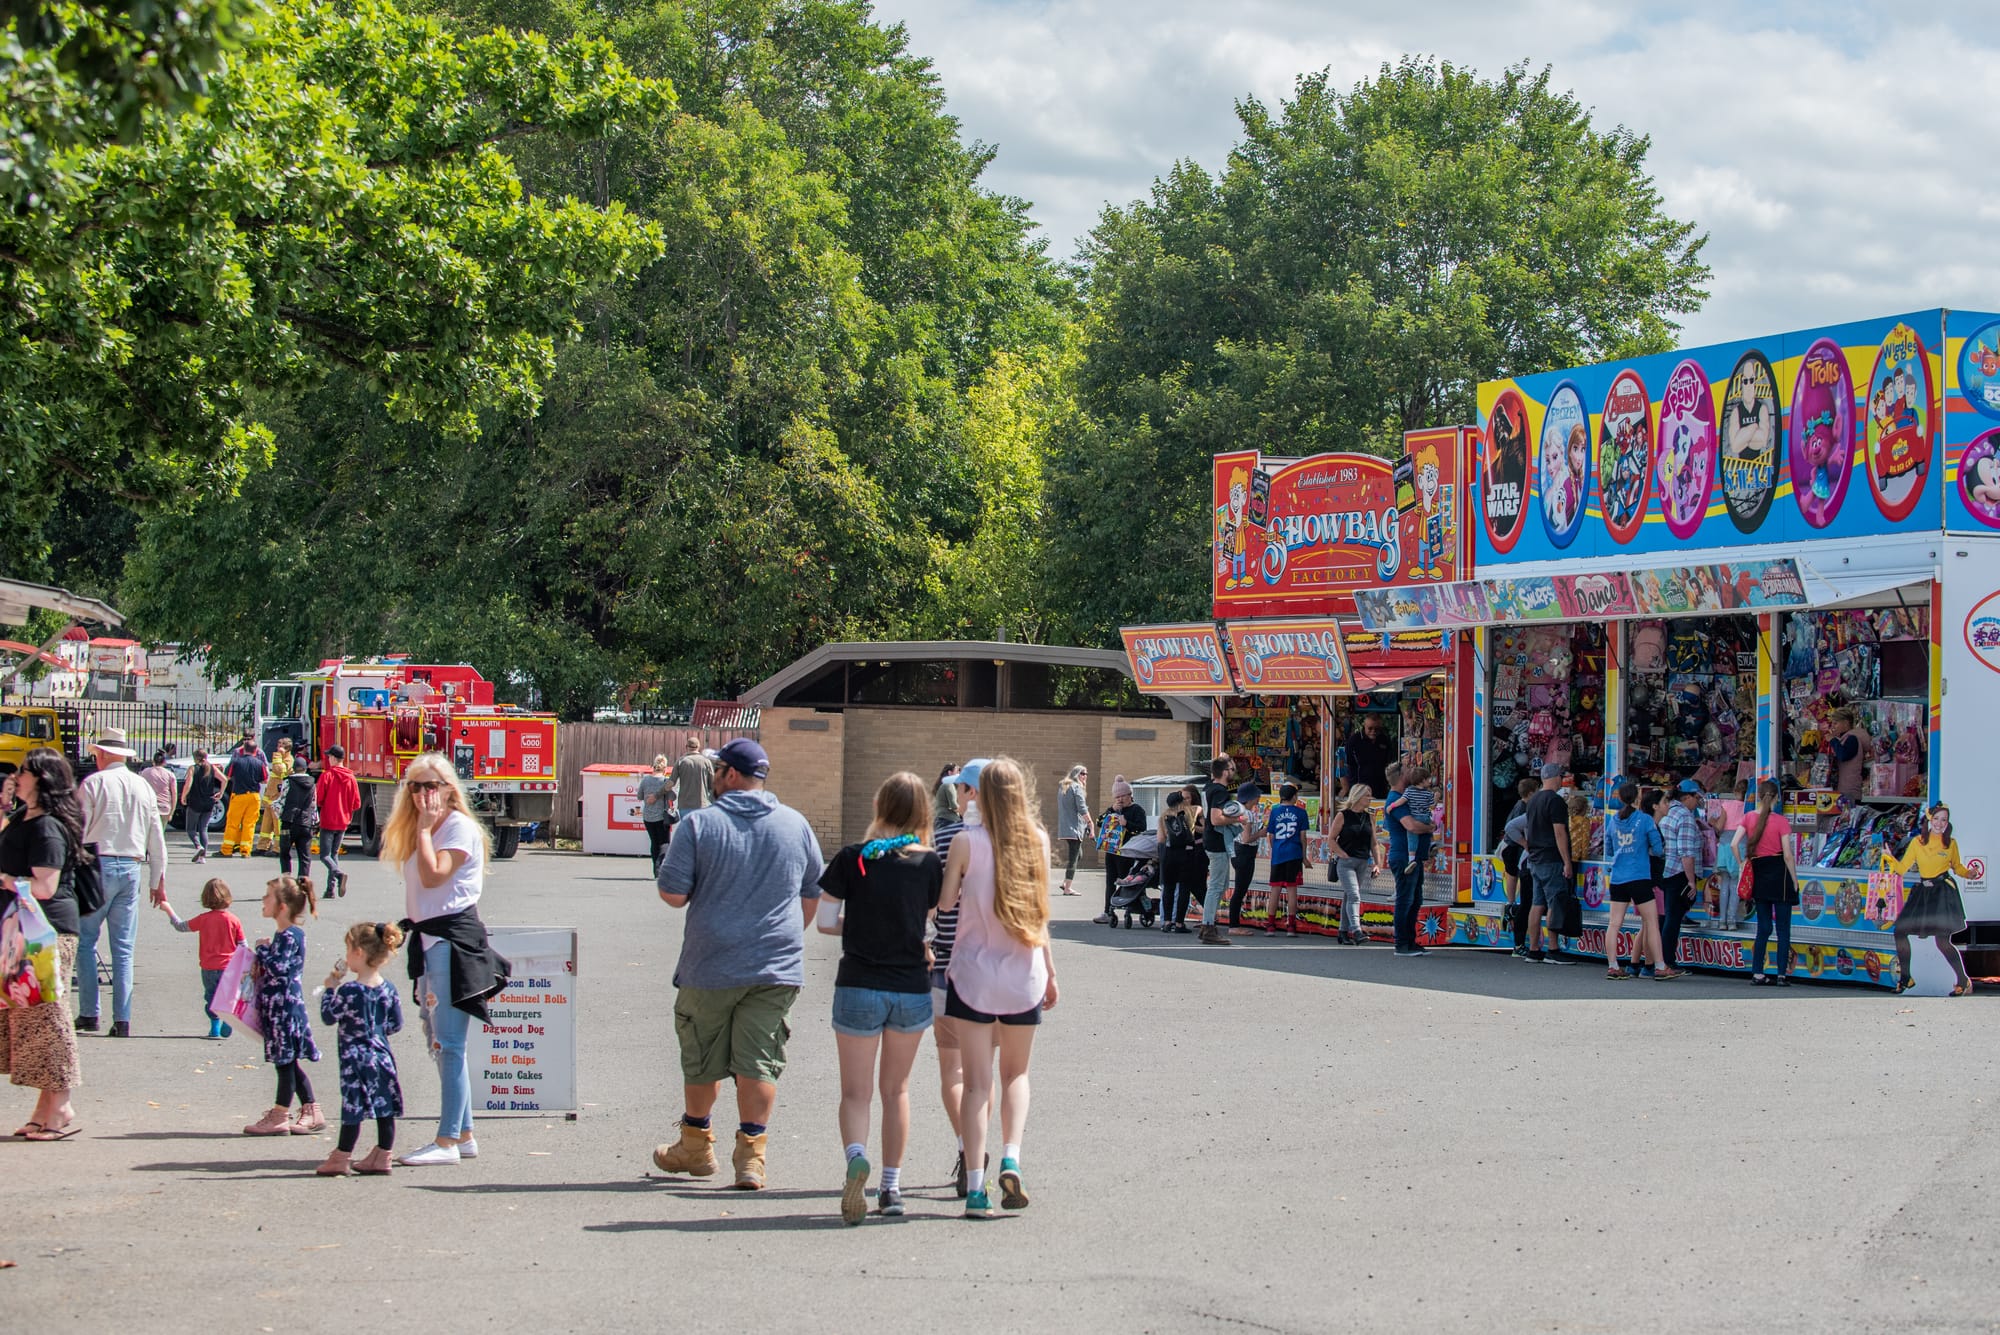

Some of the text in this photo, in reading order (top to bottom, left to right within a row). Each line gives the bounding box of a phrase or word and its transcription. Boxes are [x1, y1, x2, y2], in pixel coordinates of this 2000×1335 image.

[1882, 334, 1918, 362] Wiggles
[1663, 380, 1700, 421] PONY
[1297, 468, 1358, 489] Established 1983
[1487, 482, 1520, 501] STAR
[1486, 499, 1520, 518] WARS
[1262, 506, 1401, 586] SHOWBAG
[1292, 567, 1371, 583] FACTORY
[1574, 582, 1618, 614] Dance
[1134, 635, 1225, 684] SHOWBAG
[1241, 630, 1343, 684] SHOWBAG
[1516, 656, 1526, 664] 20
[1737, 655, 1757, 667] SWAT
[1157, 671, 1210, 681] FACTORY
[1267, 669, 1326, 680] FACTORY
[461, 720, 501, 728] NILMA NORTH
[1275, 821, 1298, 840] 25
[528, 978, 552, 988] Rolls
[500, 993, 540, 1004] Schnitzel
[544, 994, 568, 1004] Rolls
[488, 1008, 542, 1019] Hamburgers
[482, 1024, 545, 1035] Dagwood Dog
[492, 1039, 535, 1050] Hot Dogs
[491, 1054, 536, 1066] Hot Chips
[483, 1070, 543, 1080] Potato Cakes
[491, 1085, 535, 1095] Dim Sims
[486, 1100, 540, 1111] Cold Drinks
